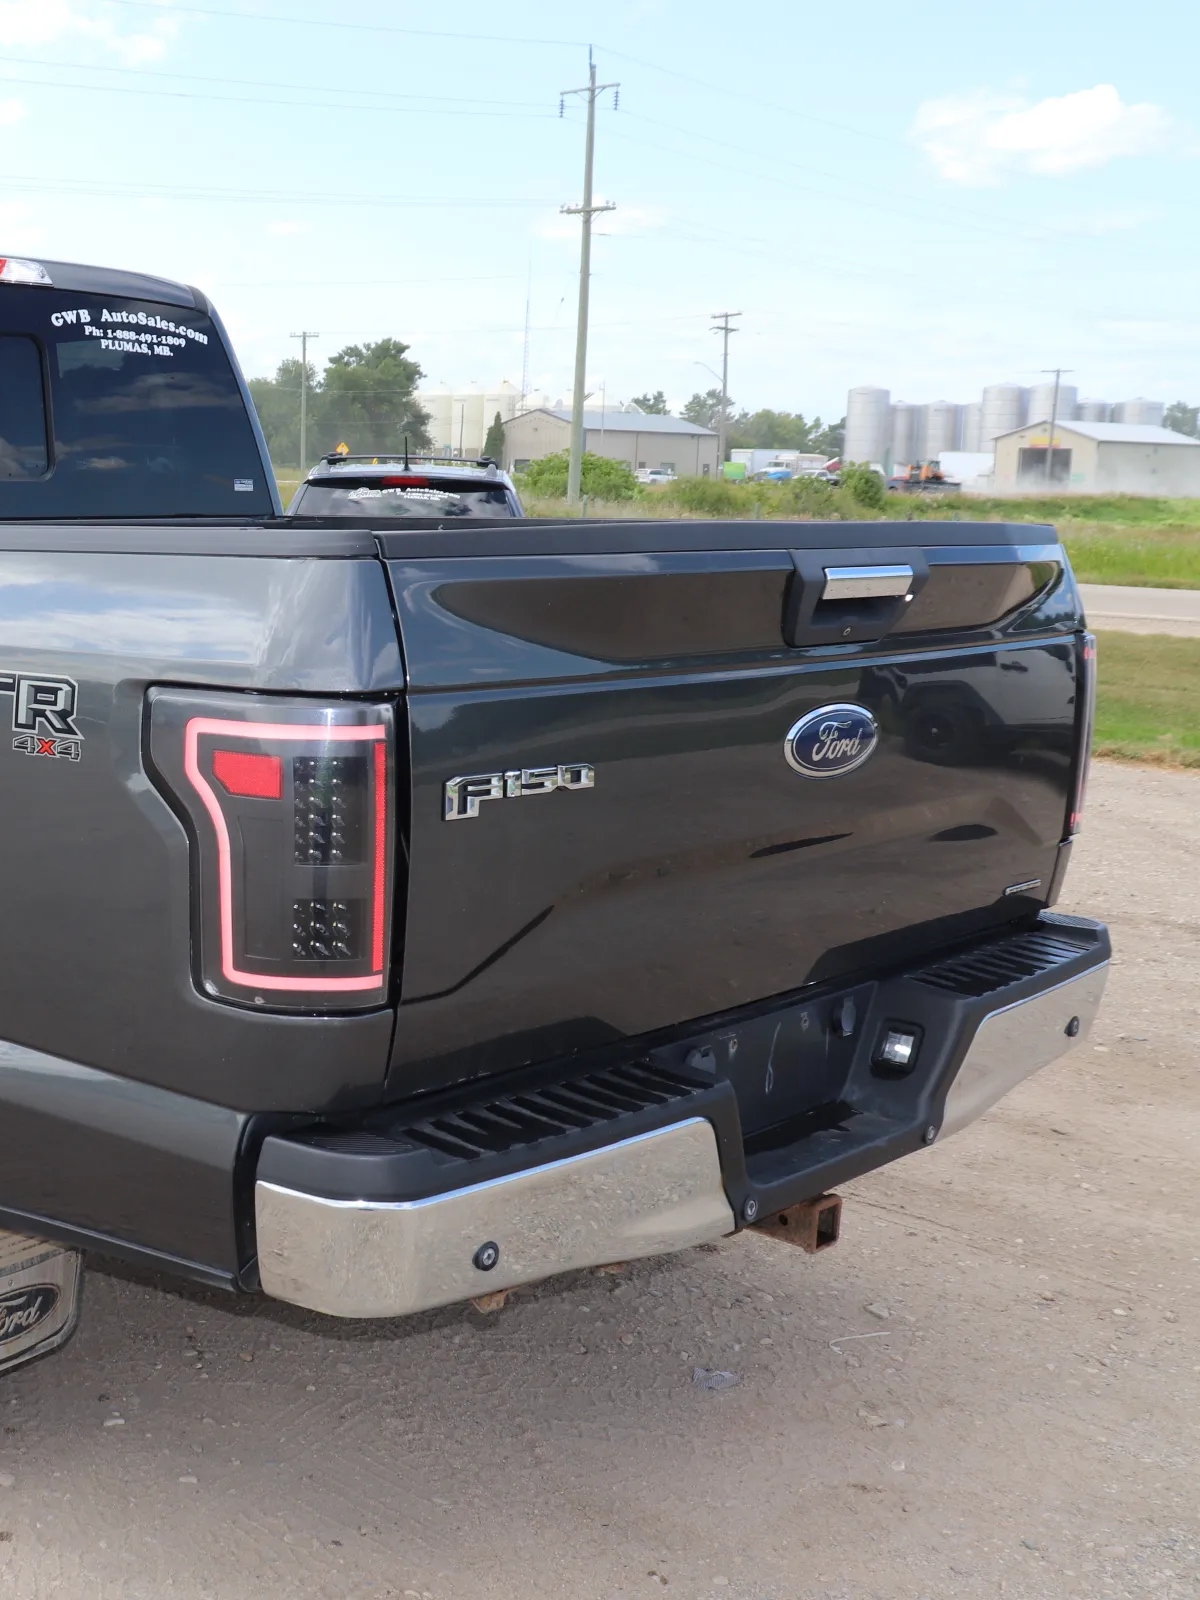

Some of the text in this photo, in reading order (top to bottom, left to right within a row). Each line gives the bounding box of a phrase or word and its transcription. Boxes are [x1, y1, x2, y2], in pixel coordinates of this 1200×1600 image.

[50, 308, 208, 345] GWB AutoSales.com
[84, 325, 186, 348] Ph: 1-888-491-1809
[100, 339, 174, 357] PLUMAS, MB.
[811, 720, 863, 762] Ford
